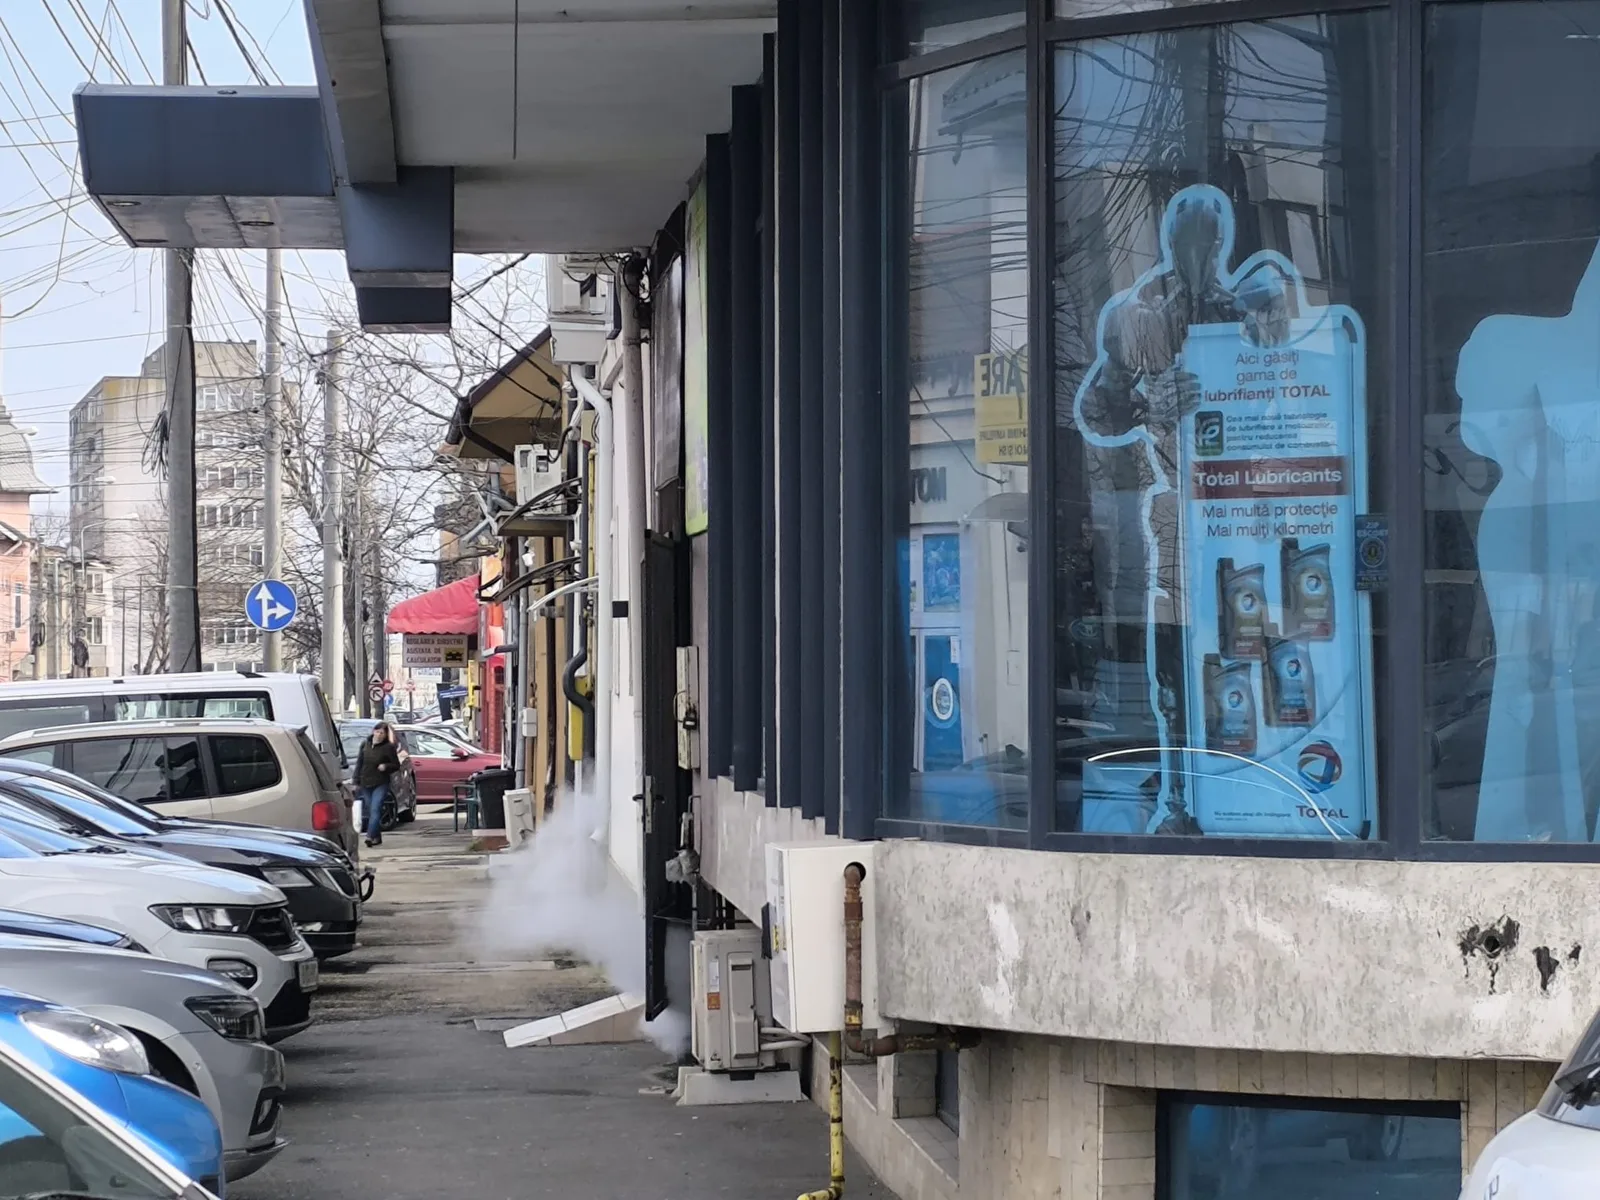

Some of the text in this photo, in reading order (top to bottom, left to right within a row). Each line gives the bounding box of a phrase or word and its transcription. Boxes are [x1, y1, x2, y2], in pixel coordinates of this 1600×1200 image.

[1236, 352, 1259, 365] Aici
[1236, 368, 1297, 386] gama de
[1279, 384, 1331, 398] TOTAL
[1226, 424, 1237, 432] de
[1195, 467, 1342, 487] Total Lubricants
[1202, 505, 1227, 518] Mai
[1231, 503, 1270, 517] multă
[1207, 524, 1232, 537] Mai
[1273, 520, 1333, 536] kilometri
[1296, 805, 1349, 818] TOTAL
